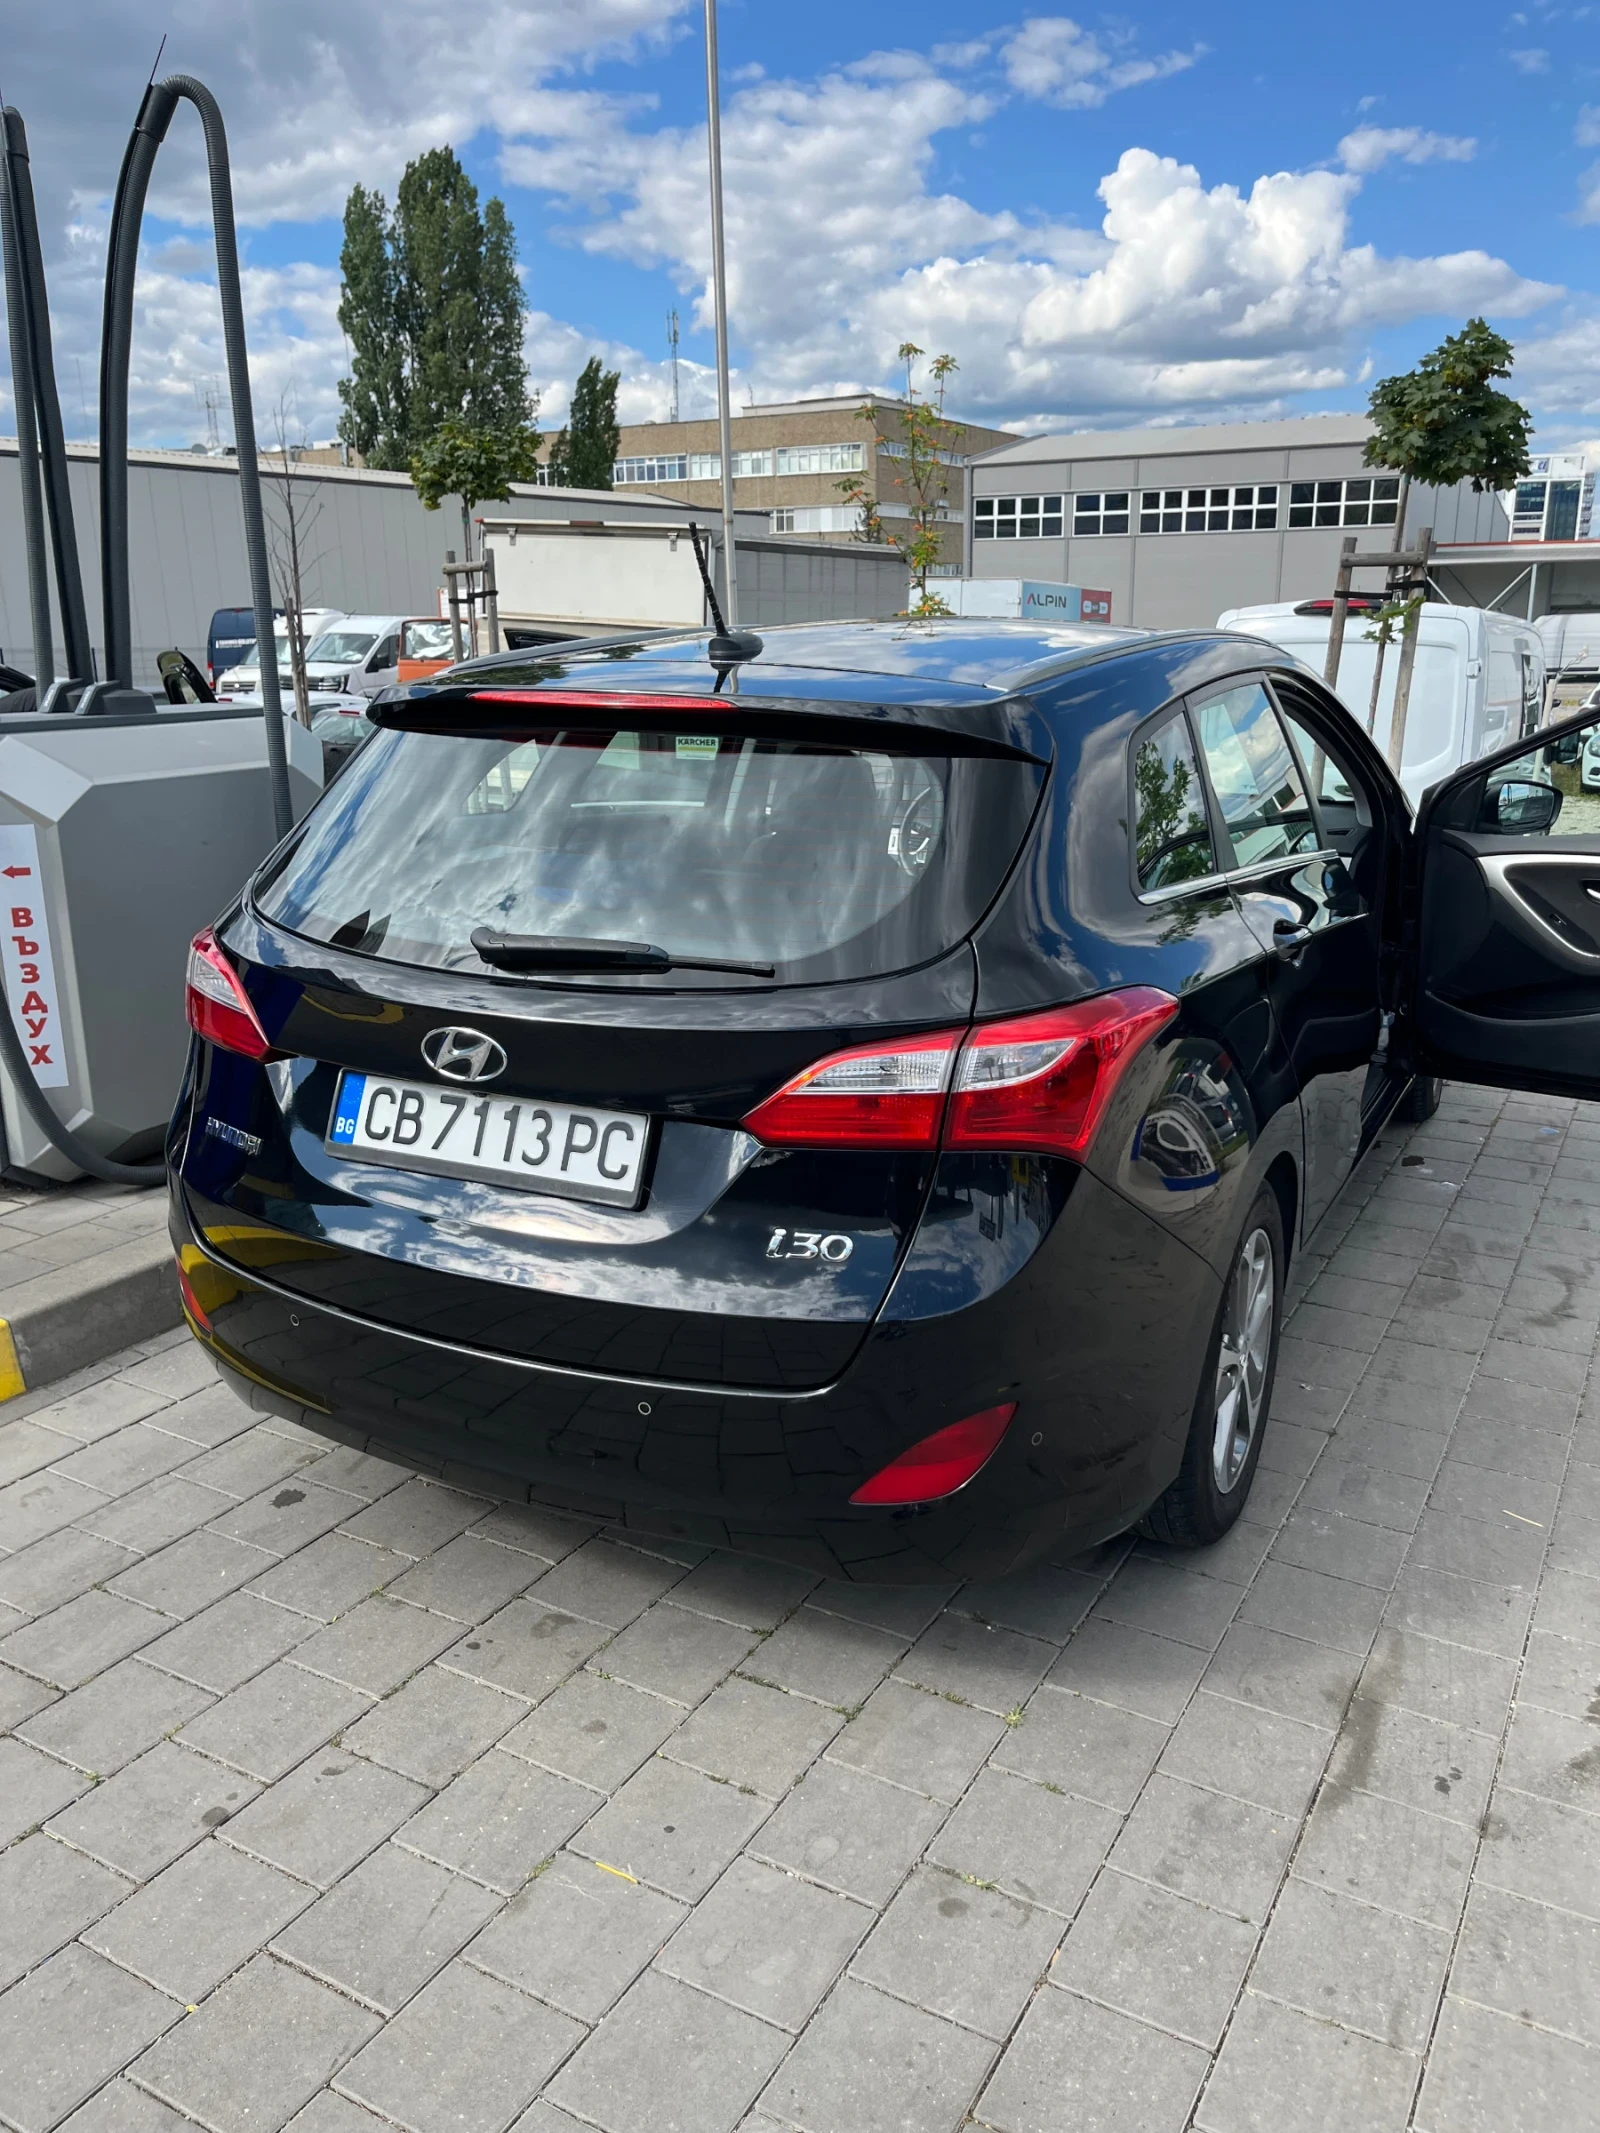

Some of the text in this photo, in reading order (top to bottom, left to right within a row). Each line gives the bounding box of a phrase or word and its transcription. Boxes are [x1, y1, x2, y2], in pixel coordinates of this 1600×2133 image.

[1026, 593, 1067, 608] ALPIN
[10, 906, 54, 1066] ВЪЗДУХ
[205, 1116, 262, 1156] HYUNDAI
[335, 1116, 356, 1135] BG
[765, 1228, 854, 1263] i30
